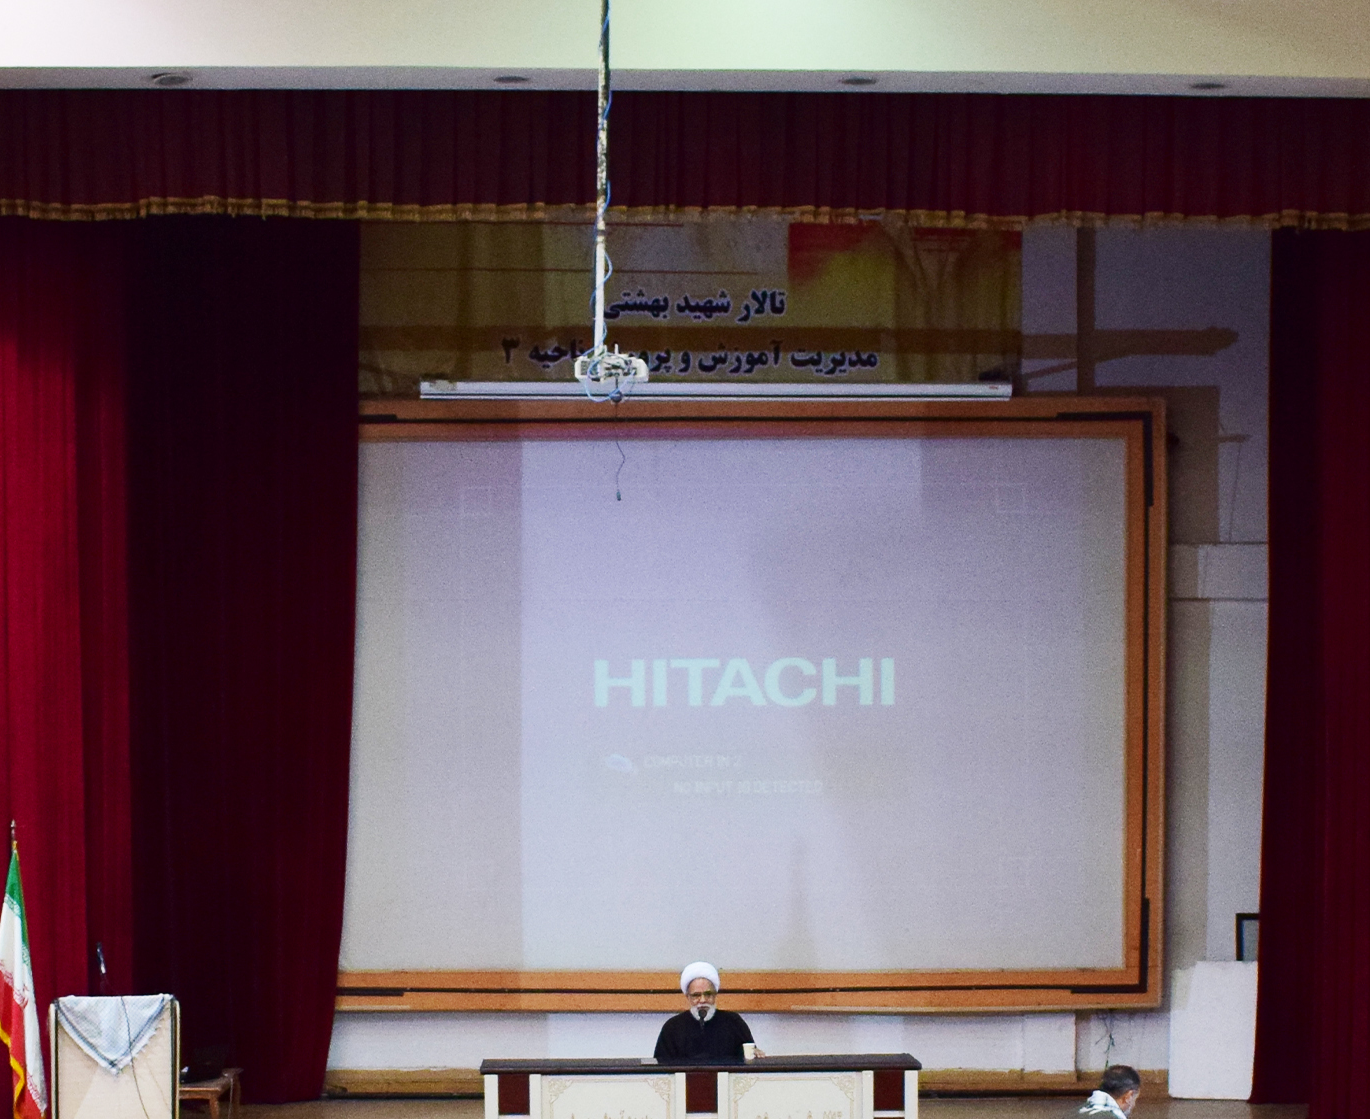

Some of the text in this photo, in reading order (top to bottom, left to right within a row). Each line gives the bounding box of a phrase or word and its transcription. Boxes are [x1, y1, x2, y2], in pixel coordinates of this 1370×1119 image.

[603, 289, 786, 323] تالار شهید بهشتی
[678, 351, 691, 373] و
[697, 340, 782, 373] آموزش
[790, 347, 878, 375] مدیریت
[593, 657, 895, 707] HITACHI
[643, 754, 714, 769] COMPUTER
